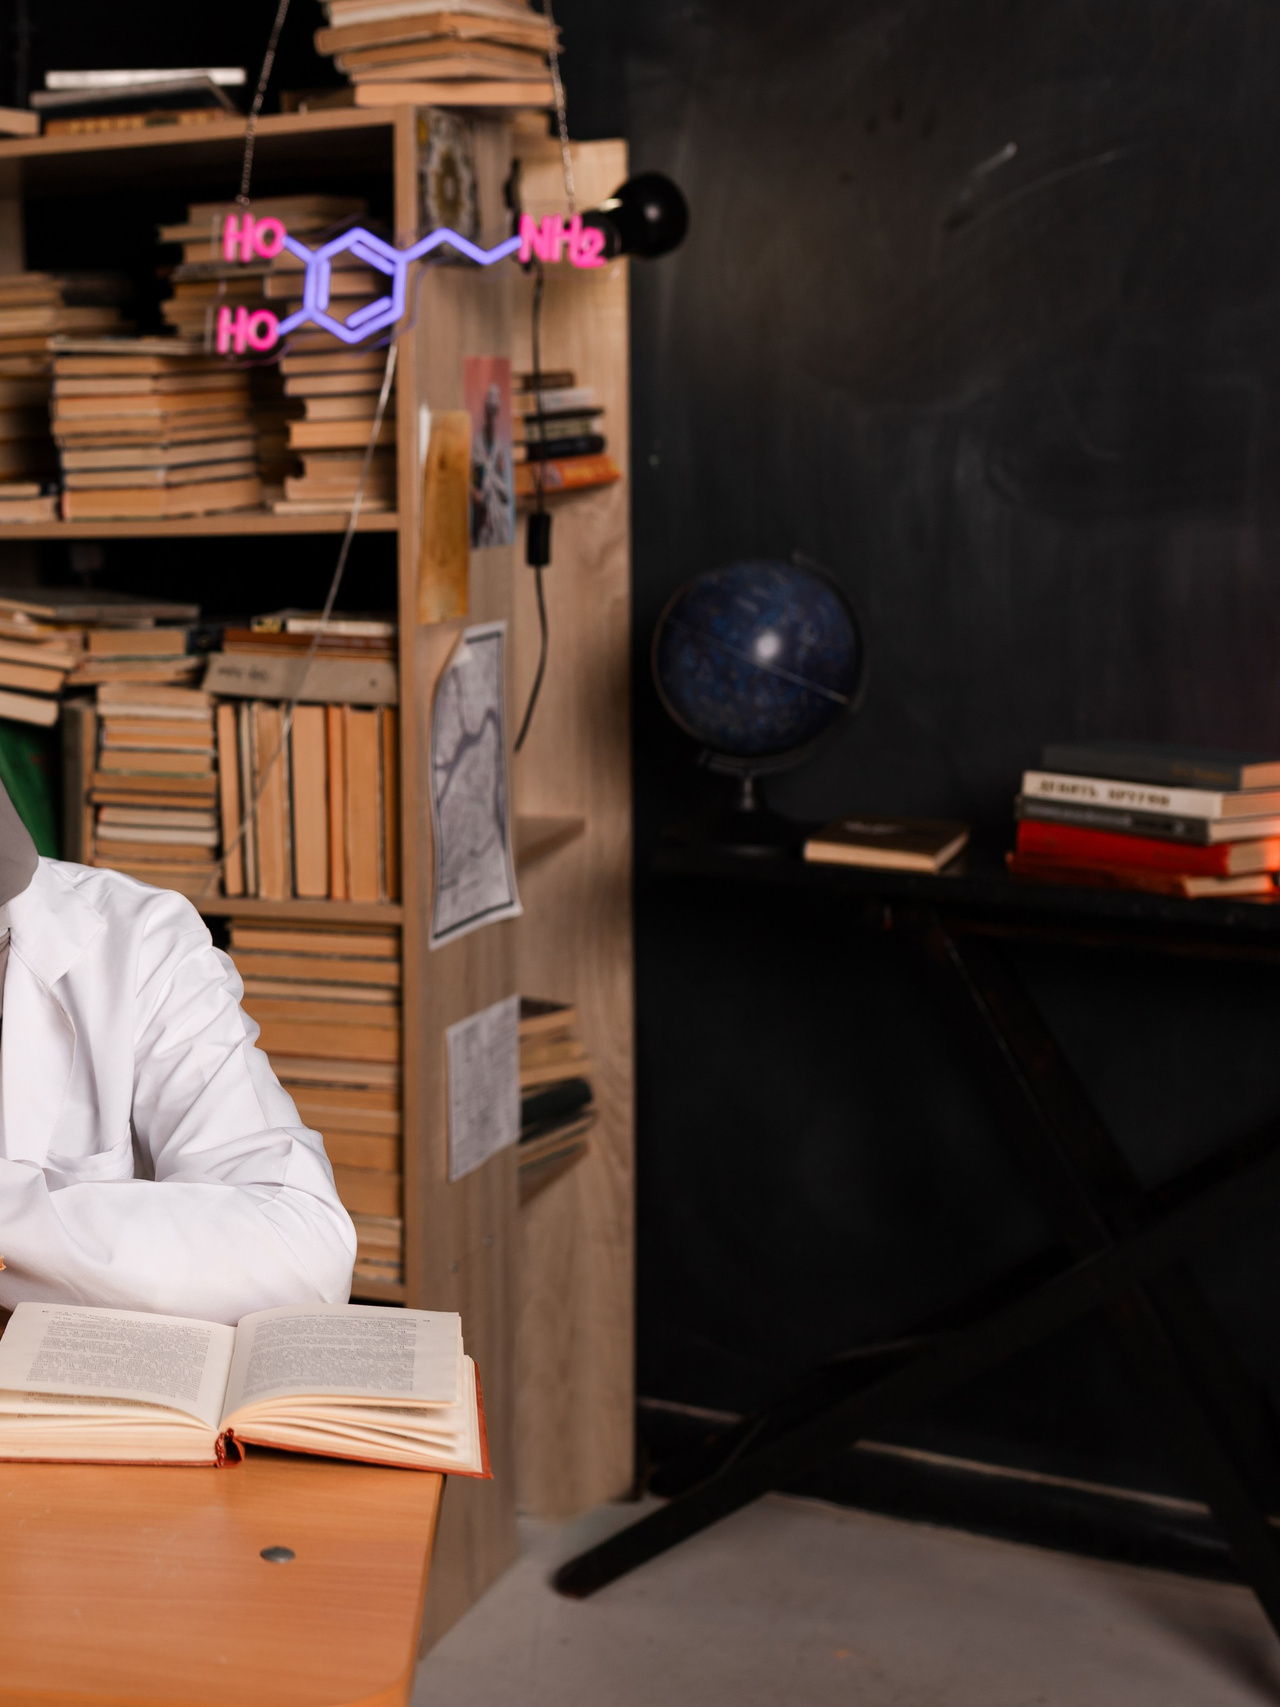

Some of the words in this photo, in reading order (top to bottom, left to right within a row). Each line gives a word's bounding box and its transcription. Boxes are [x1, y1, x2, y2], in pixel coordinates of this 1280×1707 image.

[223, 213, 287, 263] HO
[518, 212, 607, 269] NH2
[216, 306, 280, 354] HO
